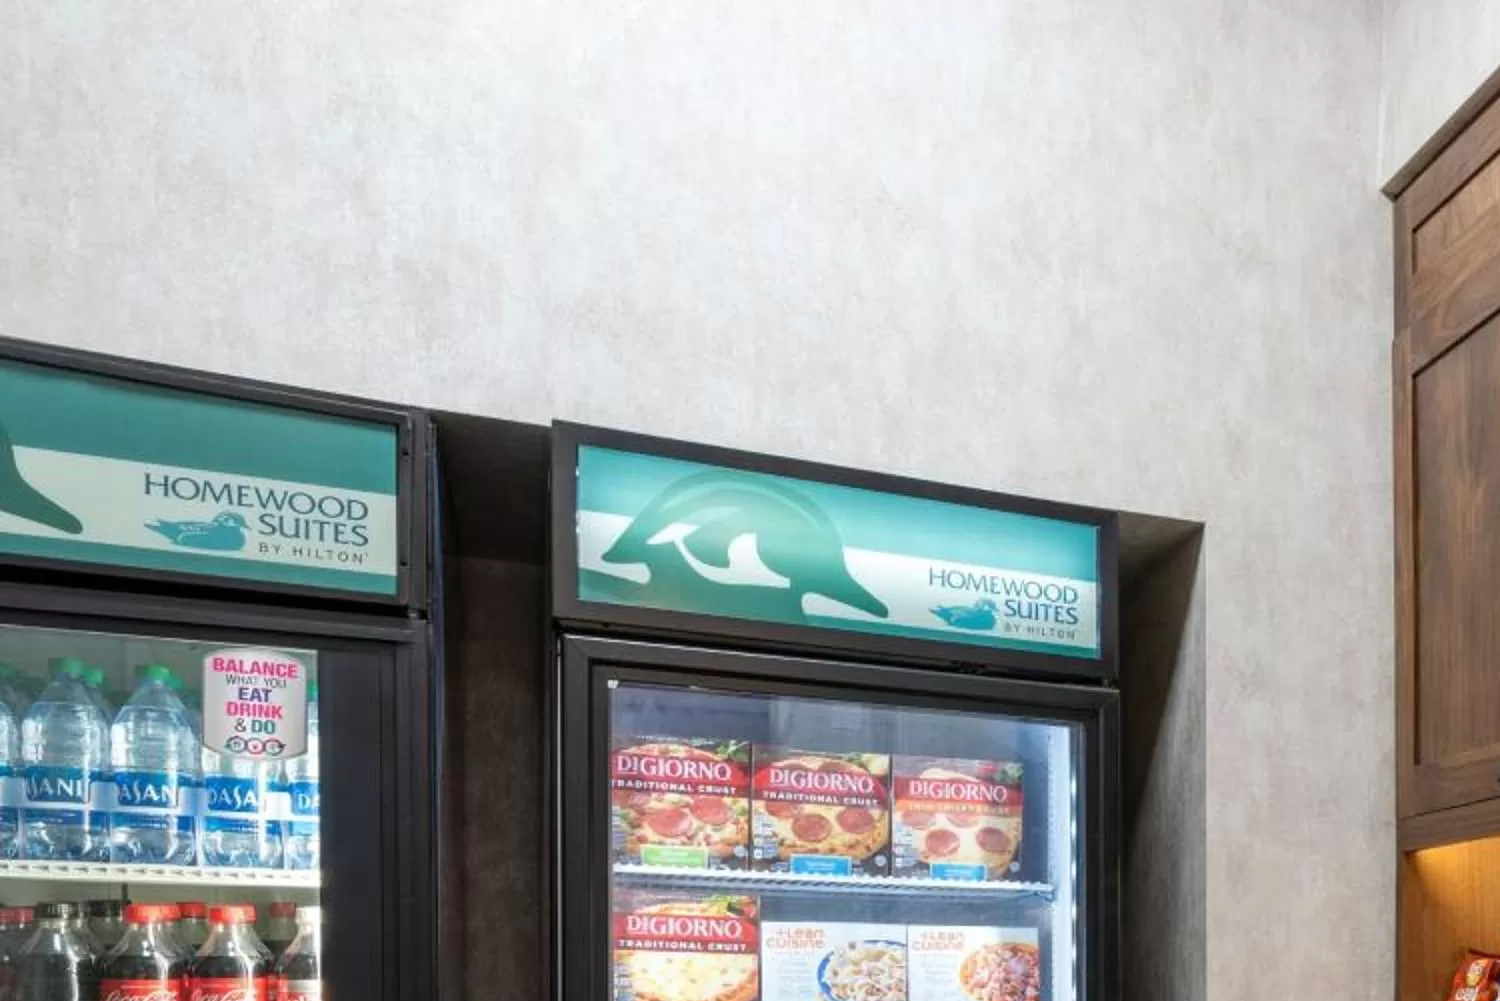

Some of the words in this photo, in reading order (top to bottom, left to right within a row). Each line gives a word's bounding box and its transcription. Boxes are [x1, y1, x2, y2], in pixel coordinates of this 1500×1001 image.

[144, 472, 369, 521] HOMEWOOD
[258, 513, 369, 547] SUITES
[259, 542, 281, 555] BY
[292, 547, 364, 565] HILTON
[928, 567, 1078, 604] HOMEWOOD
[1004, 599, 1079, 625] SUITES
[1004, 624, 1024, 634] BY
[1027, 626, 1076, 640] HILTON
[213, 657, 298, 678] BALANCE
[226, 673, 256, 685] WHAT
[263, 677, 286, 688] YOU
[239, 687, 272, 702] EAT
[226, 701, 283, 719] DRINK
[234, 718, 247, 733] &
[251, 719, 276, 734] DO
[616, 755, 732, 781] DIGIORNO
[769, 768, 874, 794] DIGIORNO
[908, 780, 1008, 802] DIGIORNO
[626, 914, 742, 940] DIGIORNO
[619, 939, 704, 951] TRADITIONAL
